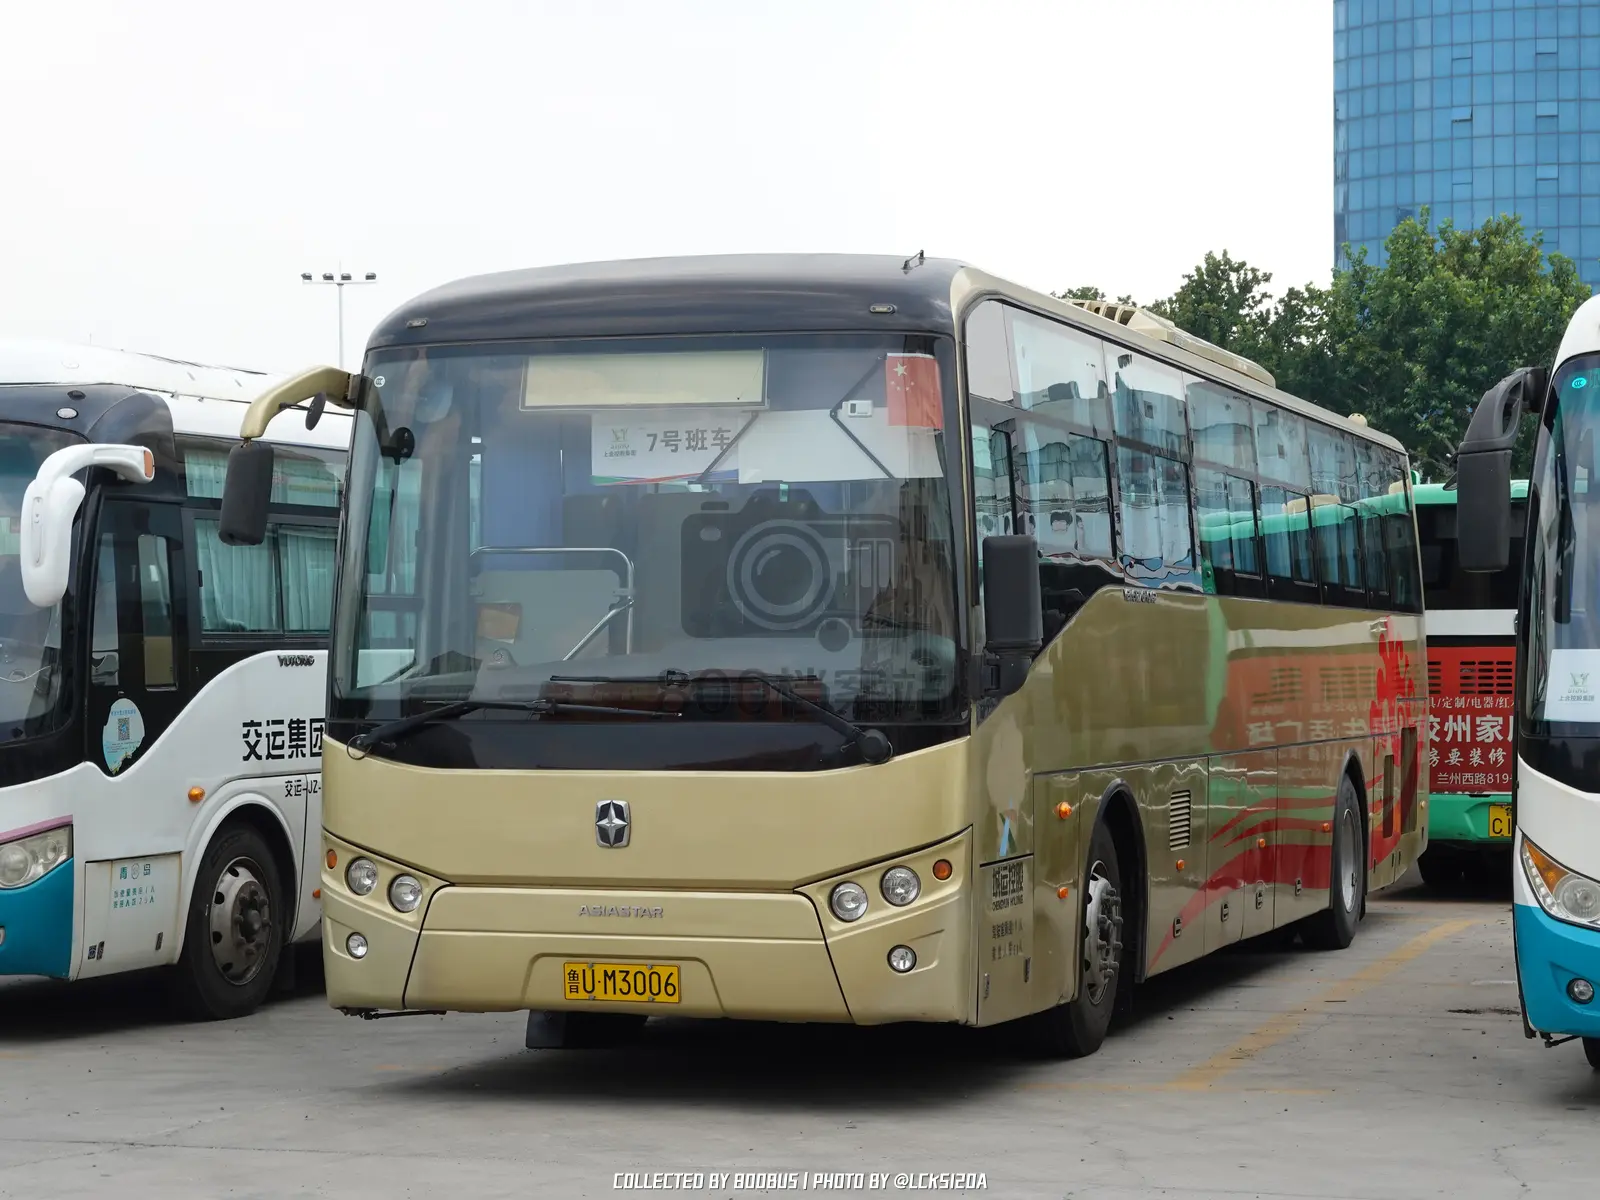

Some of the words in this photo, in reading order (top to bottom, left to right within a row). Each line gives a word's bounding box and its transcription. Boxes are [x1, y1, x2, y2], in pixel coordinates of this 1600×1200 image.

[646, 427, 731, 453] 7号班车
[277, 655, 315, 667] YUTONG
[242, 718, 325, 761] 交运集团
[1437, 772, 1512, 785] 兰州西路819
[579, 905, 664, 918] ASIASTAR
